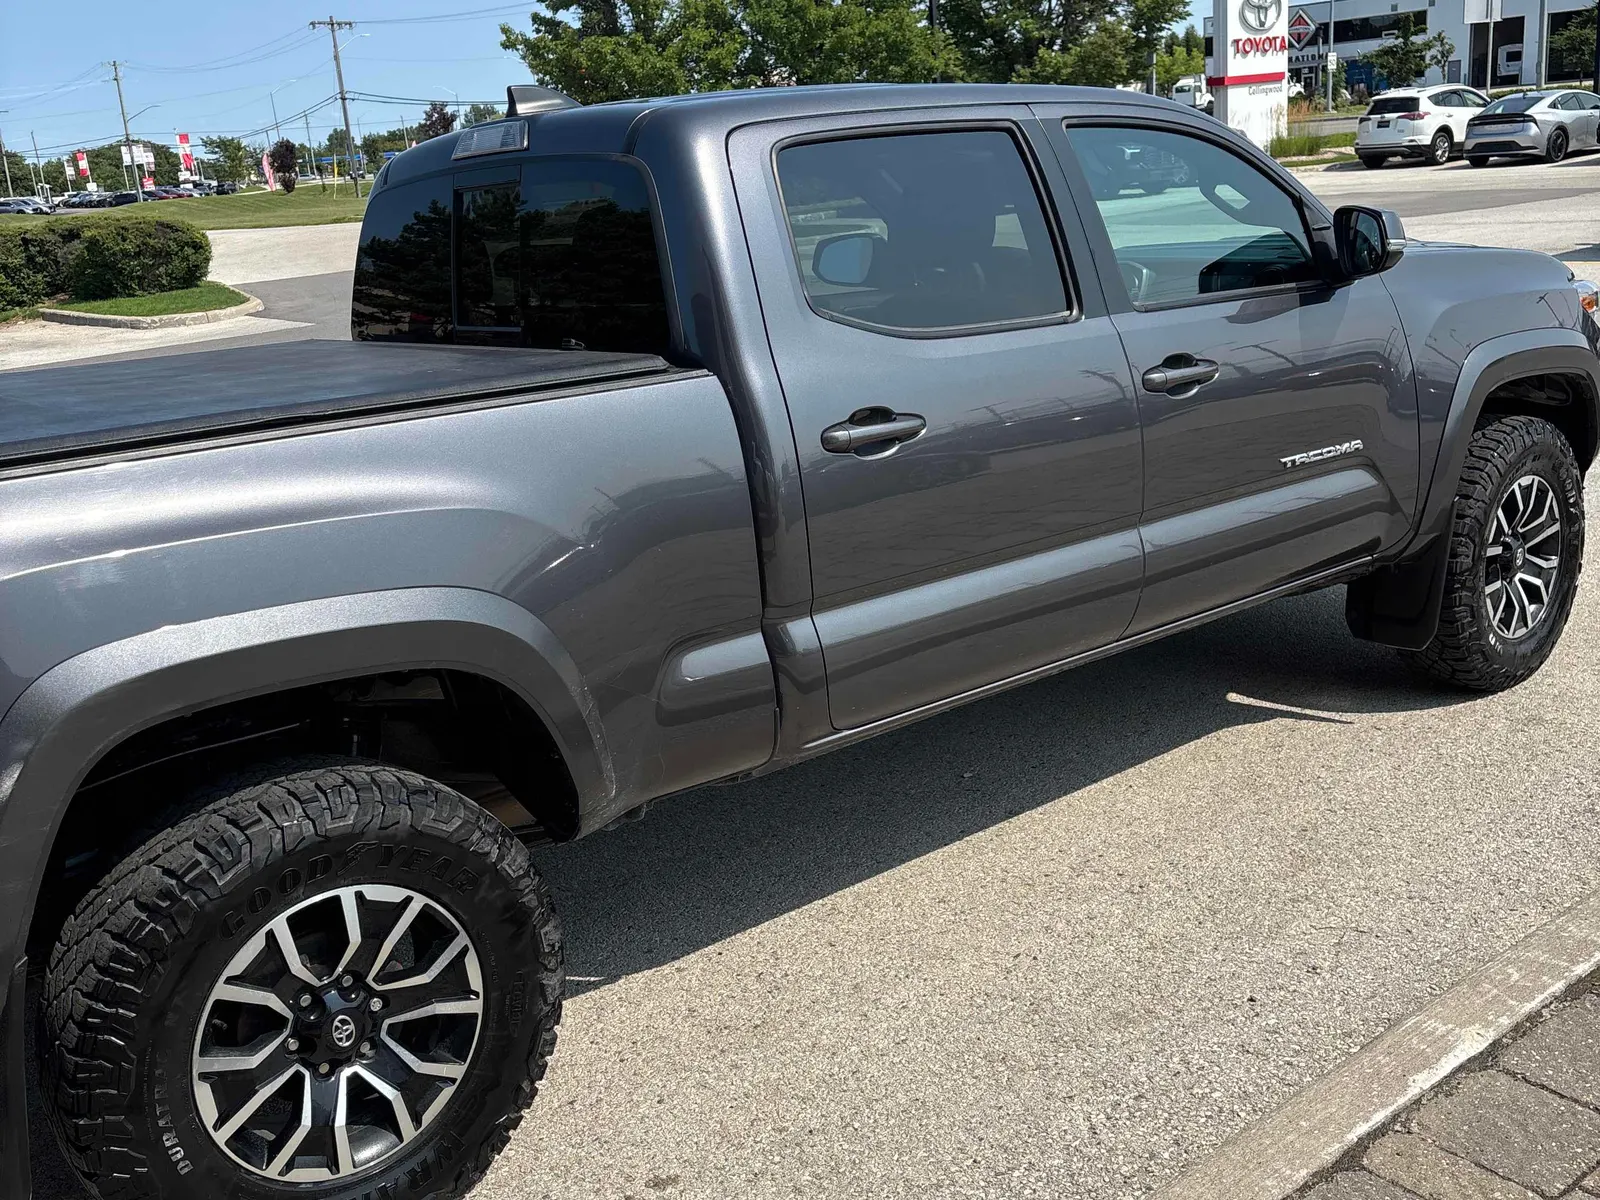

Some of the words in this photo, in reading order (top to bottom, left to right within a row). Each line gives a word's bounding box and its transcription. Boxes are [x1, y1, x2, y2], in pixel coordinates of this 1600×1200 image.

[1232, 36, 1288, 54] TOYOTA
[1248, 85, 1283, 96] Collingwood
[1279, 439, 1363, 468] TACOMA
[154, 1050, 194, 1176] DURATRAC
